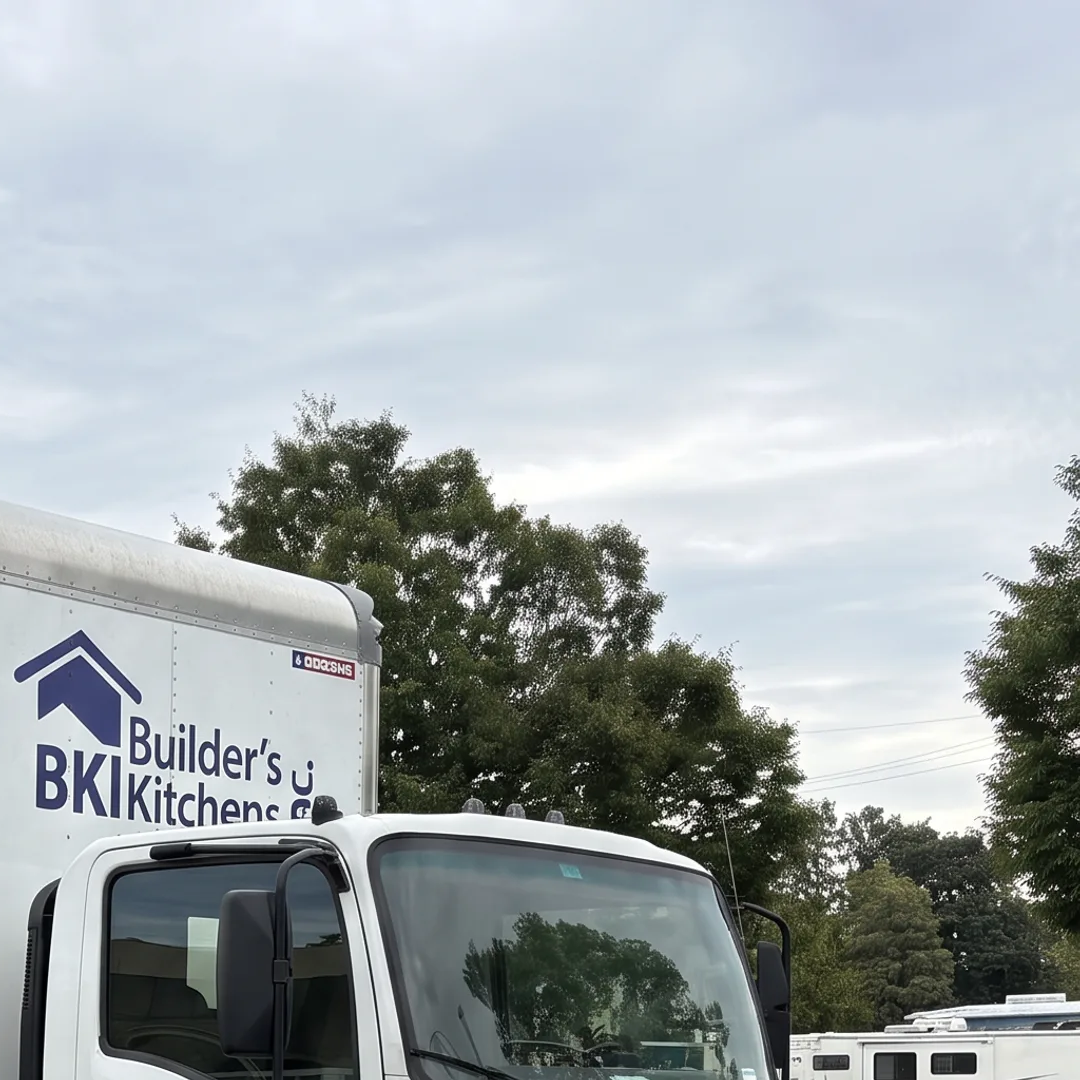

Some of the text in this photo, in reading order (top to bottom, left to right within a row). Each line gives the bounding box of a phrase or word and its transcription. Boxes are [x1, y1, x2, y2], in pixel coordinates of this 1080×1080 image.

[36, 743, 121, 819] BKI
[129, 716, 282, 786] Builder's
[128, 773, 280, 828] Kitchens
